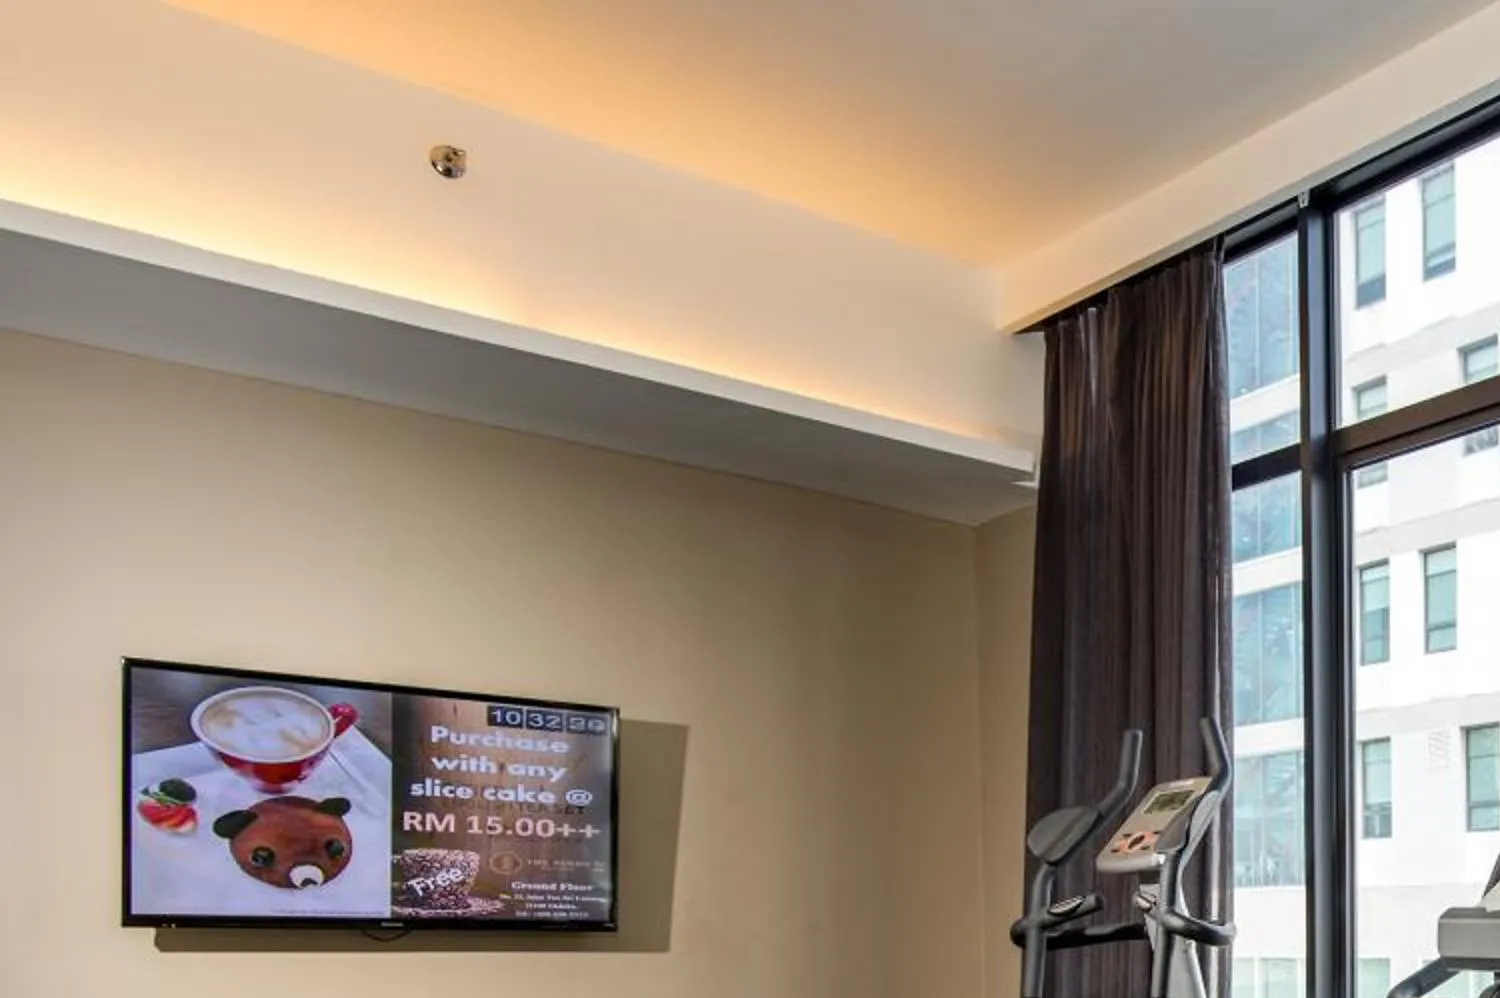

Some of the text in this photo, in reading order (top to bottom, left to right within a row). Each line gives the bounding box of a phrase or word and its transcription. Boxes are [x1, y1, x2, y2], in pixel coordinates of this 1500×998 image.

[491, 708, 521, 726] 10
[528, 712, 561, 730] 32
[431, 725, 570, 753] Purchase
[431, 754, 568, 783] with any
[410, 777, 593, 806] slice cake @
[402, 811, 602, 839] RM 15.00++
[407, 867, 464, 897] Free
